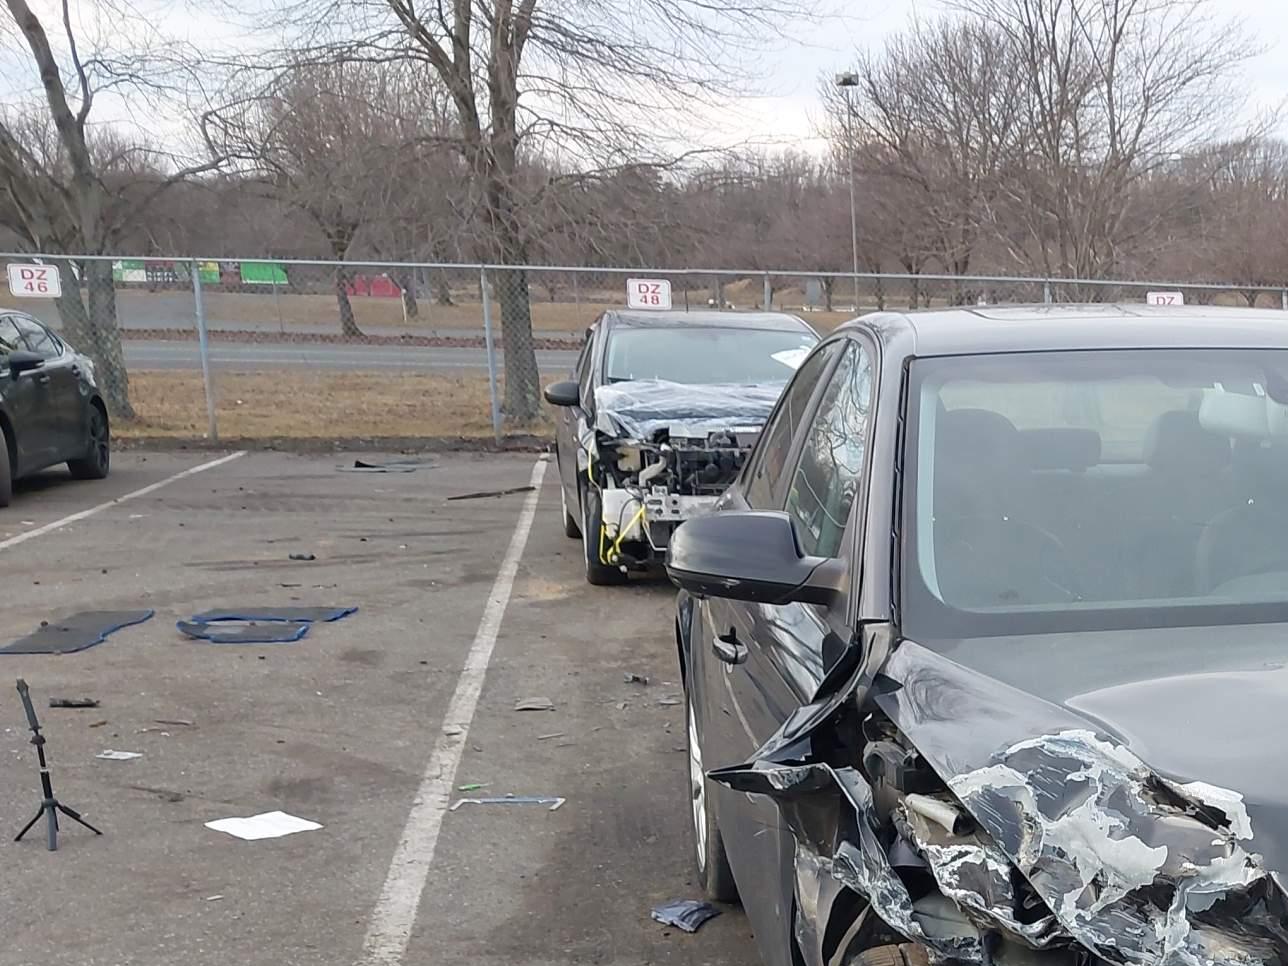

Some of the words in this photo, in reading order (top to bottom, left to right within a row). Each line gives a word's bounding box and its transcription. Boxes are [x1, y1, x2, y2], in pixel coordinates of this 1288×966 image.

[20, 268, 47, 280] DZ
[24, 281, 48, 293] 46
[638, 283, 660, 294] DZ
[639, 295, 660, 305] 48
